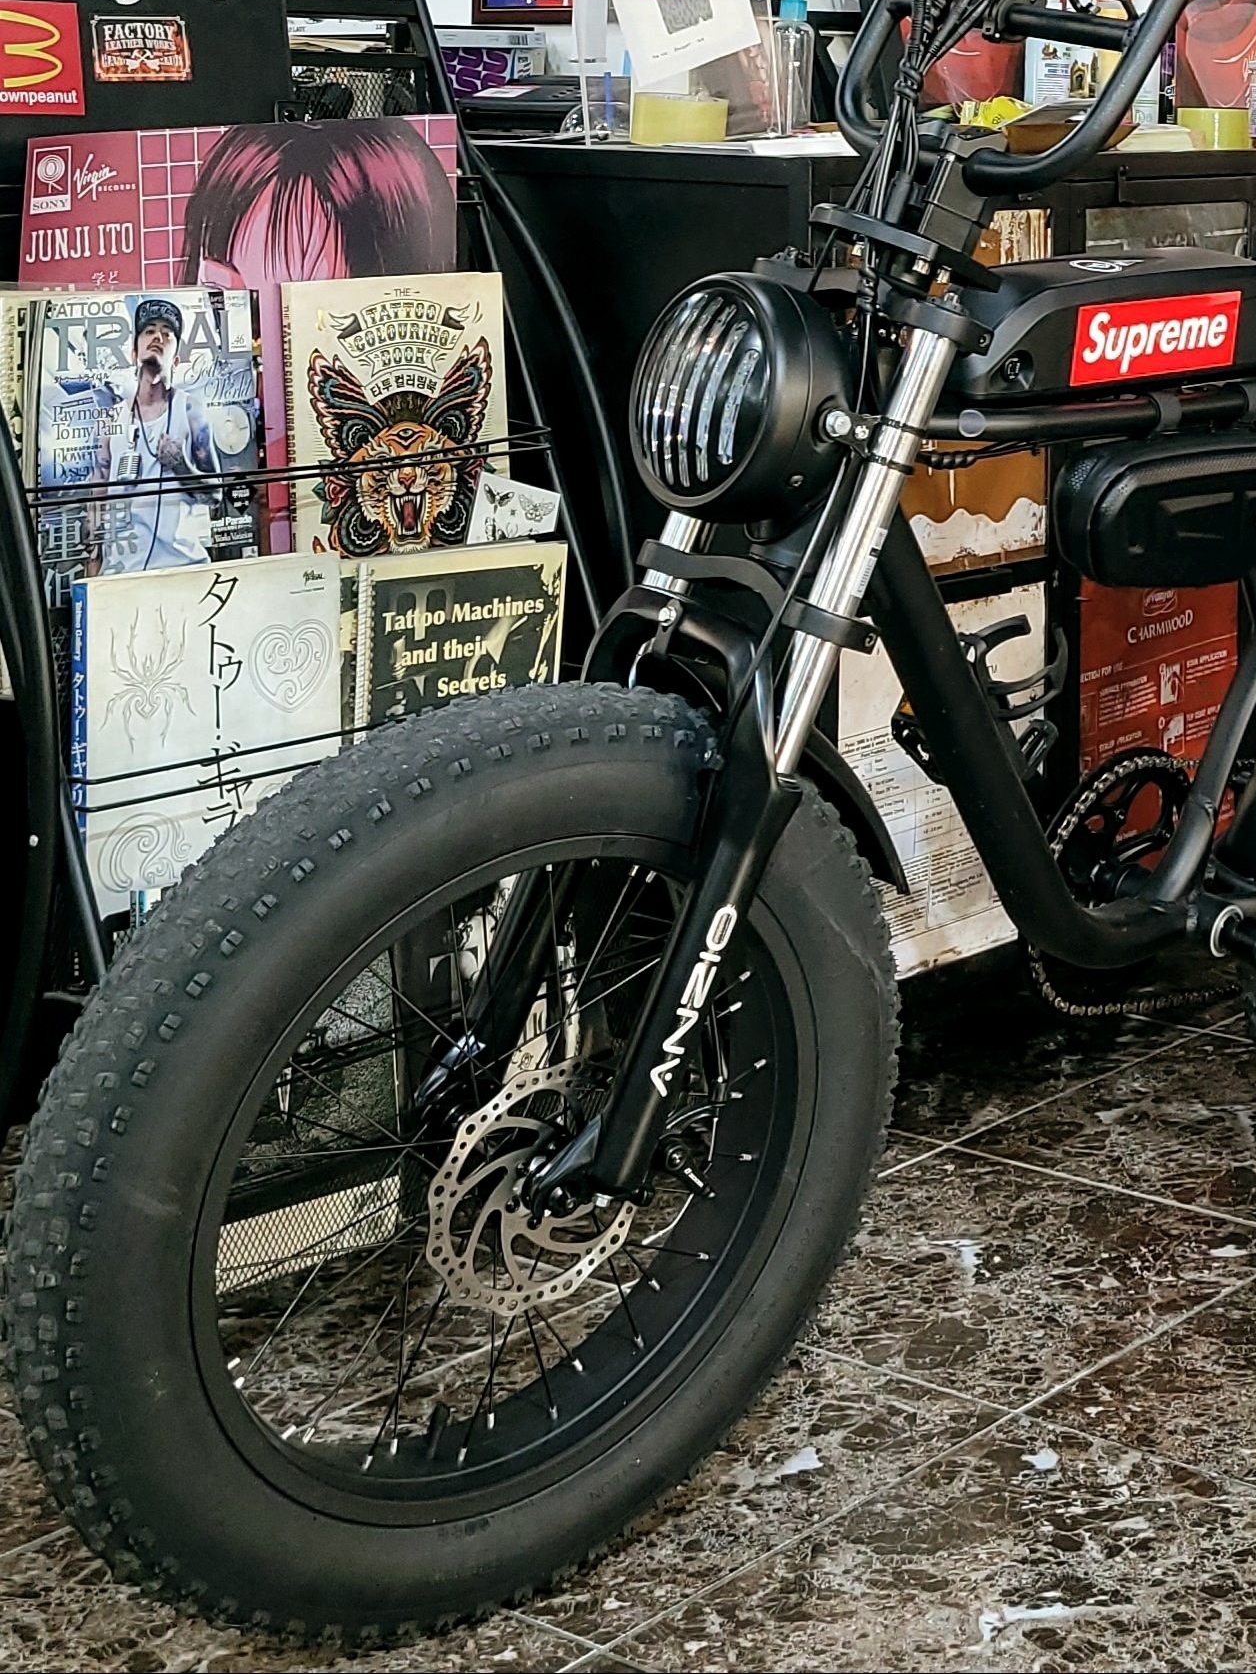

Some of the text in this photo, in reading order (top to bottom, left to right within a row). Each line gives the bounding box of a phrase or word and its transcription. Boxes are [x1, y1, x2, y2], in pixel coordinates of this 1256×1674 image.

[104, 21, 175, 41] FACTORY
[105, 37, 177, 51] LEATHER WORKS
[73, 153, 118, 201] Virgin
[97, 183, 137, 193] RECORDS
[32, 198, 69, 212] SONY
[25, 222, 134, 264] JUNJI ITO
[393, 287, 412, 297] THE
[52, 301, 116, 319] TATTOO
[364, 301, 438, 325] TATTOO
[45, 309, 252, 373] TRAL
[352, 322, 451, 352] COLOURING
[1082, 311, 1229, 374] Supreme
[381, 345, 427, 367] BOOK
[204, 372, 253, 402] World
[369, 372, 438, 398] 타투 컬러링북
[52, 405, 123, 424] Pay money
[53, 421, 124, 441] To my Pain
[382, 595, 545, 636] Tattoo Machines
[402, 635, 489, 667] and their
[437, 670, 507, 699] Secrets
[650, 903, 738, 1098] ANZIO
